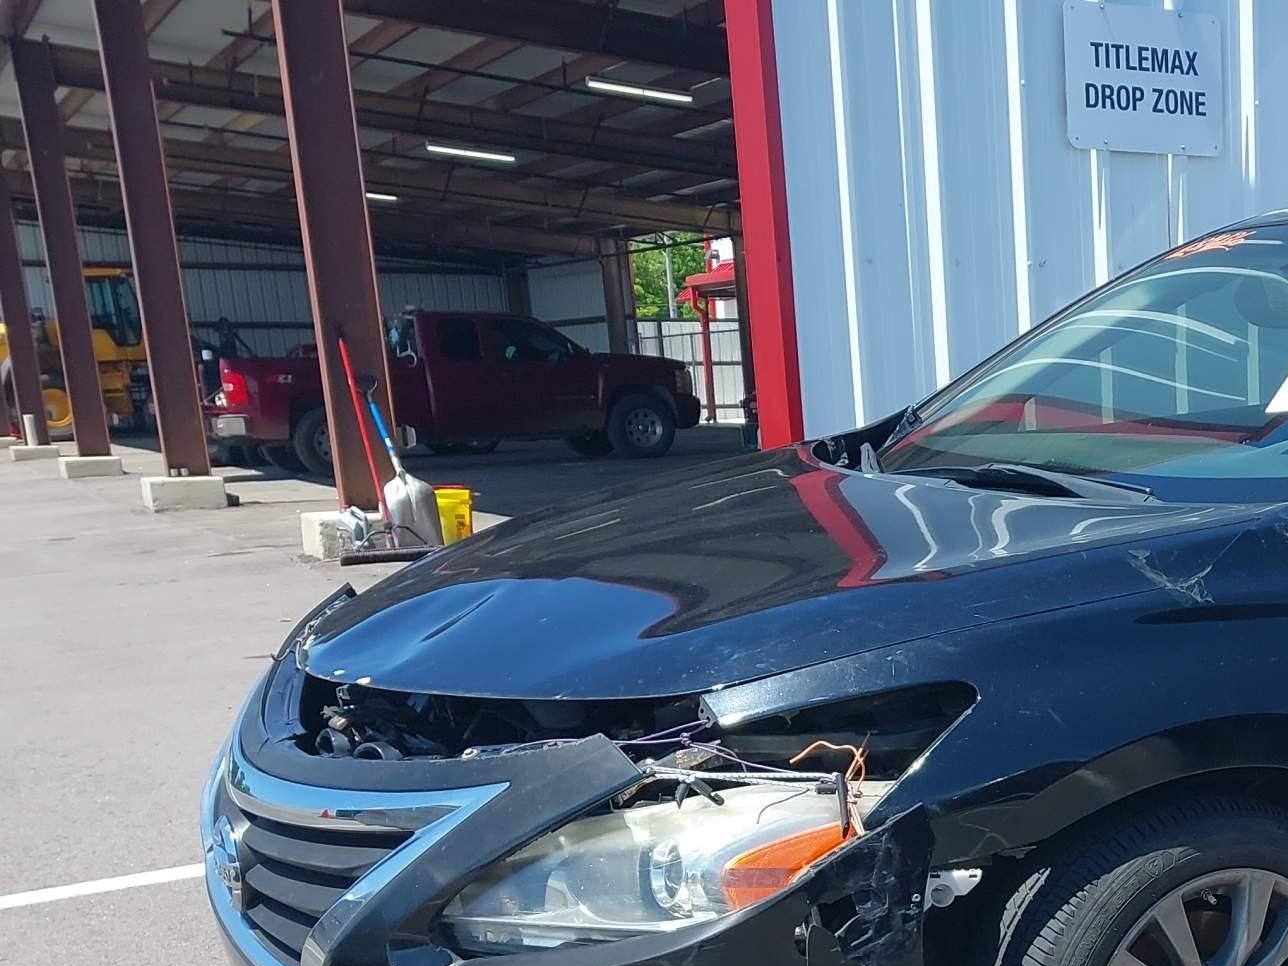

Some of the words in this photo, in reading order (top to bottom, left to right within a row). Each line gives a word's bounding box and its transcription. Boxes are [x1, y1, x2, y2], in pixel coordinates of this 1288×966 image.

[1090, 41, 1199, 77] TITLEMAX
[1085, 82, 1145, 112] DROP
[1152, 87, 1207, 117] ZONE
